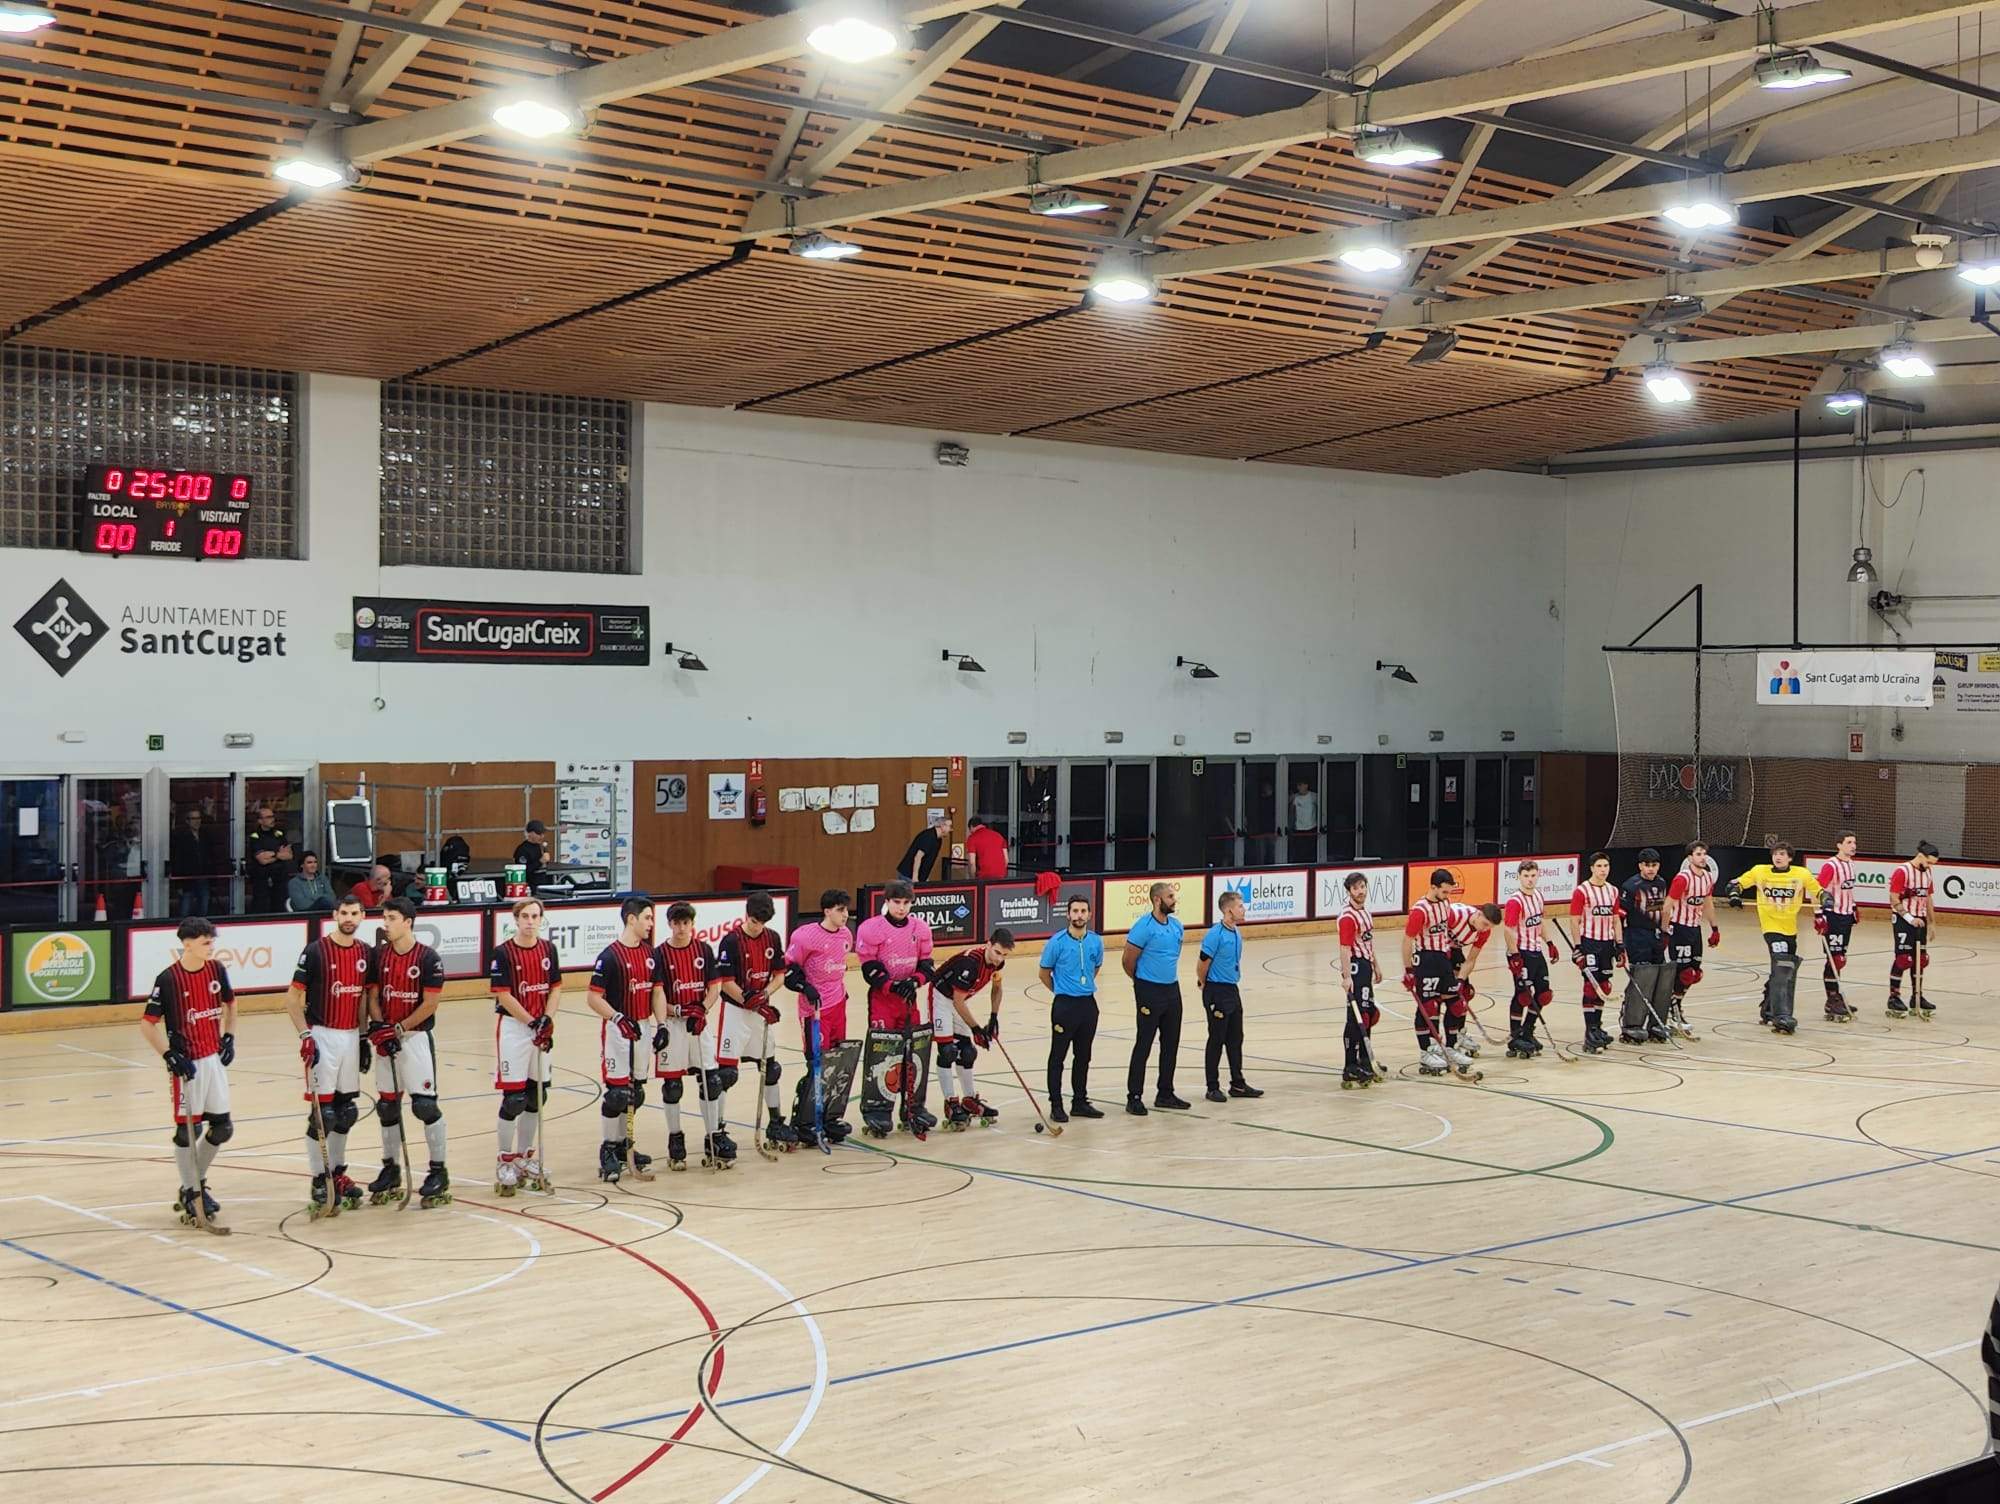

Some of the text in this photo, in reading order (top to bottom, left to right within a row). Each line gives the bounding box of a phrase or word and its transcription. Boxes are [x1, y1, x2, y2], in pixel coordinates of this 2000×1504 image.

[107, 471, 122, 490] 0
[130, 471, 211, 500] 25:00
[232, 479, 247, 498] 0
[88, 492, 111, 500] FALTES
[94, 504, 138, 518] LOCAL
[228, 500, 250, 508] FALTES
[200, 510, 242, 523] VISITANT
[164, 520, 176, 536] 1
[96, 524, 137, 550] 00
[204, 529, 242, 555] 00
[151, 541, 182, 551] PERIODE
[121, 605, 287, 628] AJUNTAMENT DE
[384, 622, 410, 630] SPORTS
[427, 615, 581, 649] SantCugatCreix
[120, 627, 287, 663] SantCugat
[1805, 672, 1920, 686] Sant Cugat amb Ucraïna
[1252, 875, 1294, 899] elektra
[1002, 907, 1038, 918] training
[1252, 900, 1294, 912] catalunya
[596, 924, 615, 932] hores
[1829, 934, 1844, 945] 24
[1898, 932, 1907, 944] 7
[1675, 945, 1692, 957] 78
[1422, 977, 1440, 991] 27
[1361, 986, 1370, 1000] 8
[723, 1038, 731, 1049] 8
[661, 1051, 668, 1062] 9
